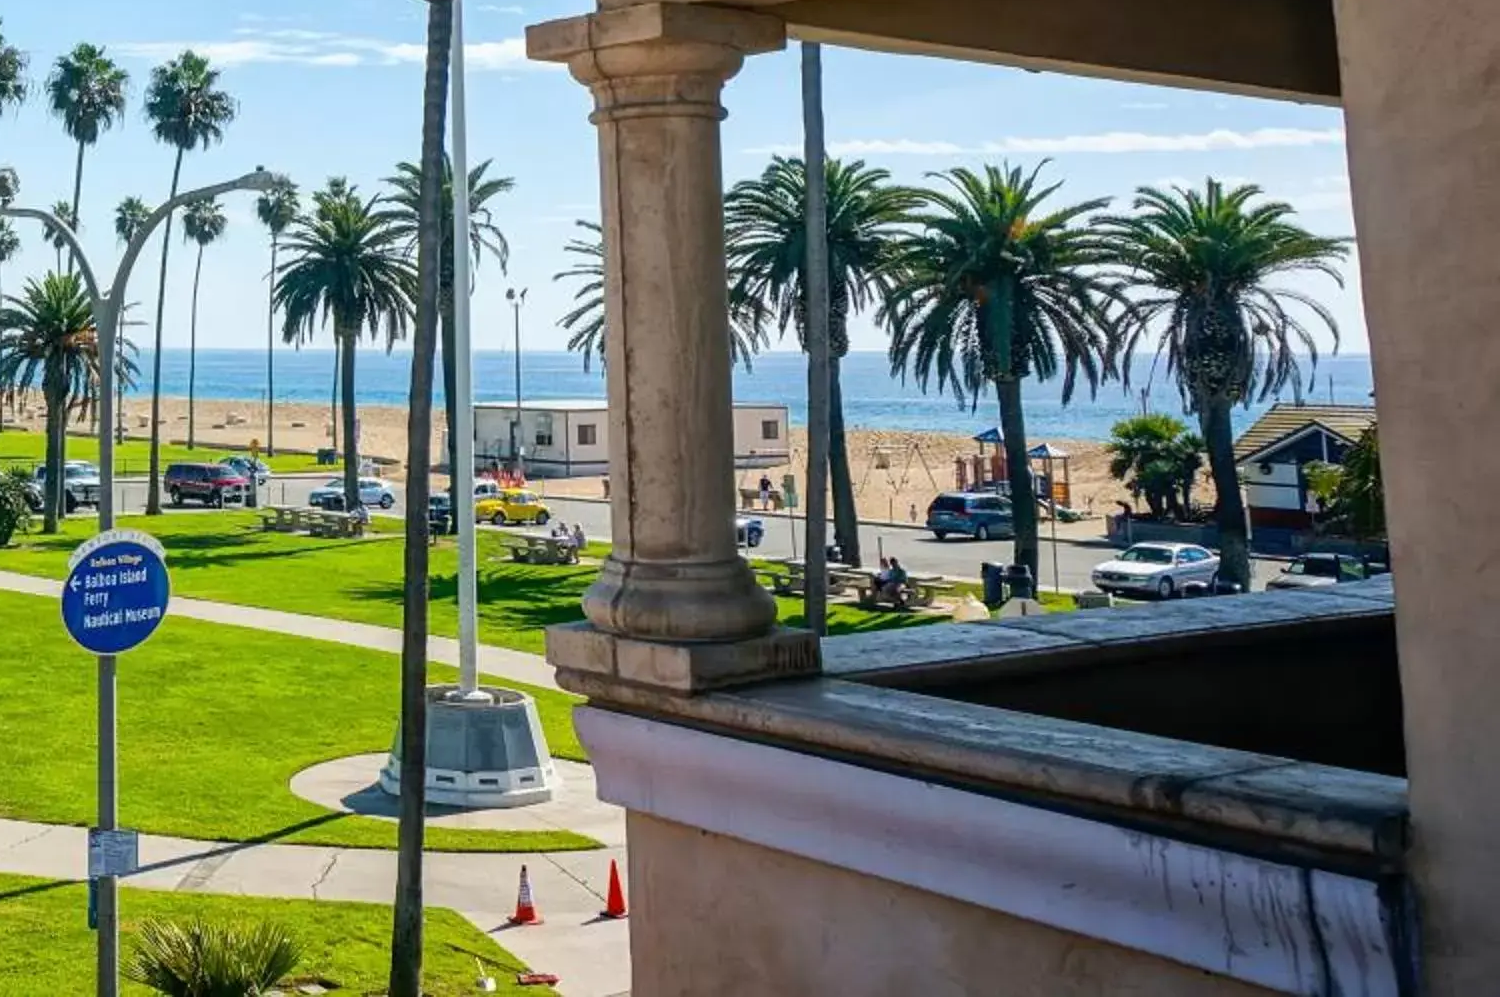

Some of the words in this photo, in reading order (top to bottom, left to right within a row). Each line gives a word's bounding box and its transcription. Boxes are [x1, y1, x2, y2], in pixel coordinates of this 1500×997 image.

[85, 572, 117, 589] Balboa
[120, 567, 147, 584] Island
[84, 592, 108, 607] Ferry
[83, 608, 122, 629] Nautical
[125, 606, 161, 623] Museum
